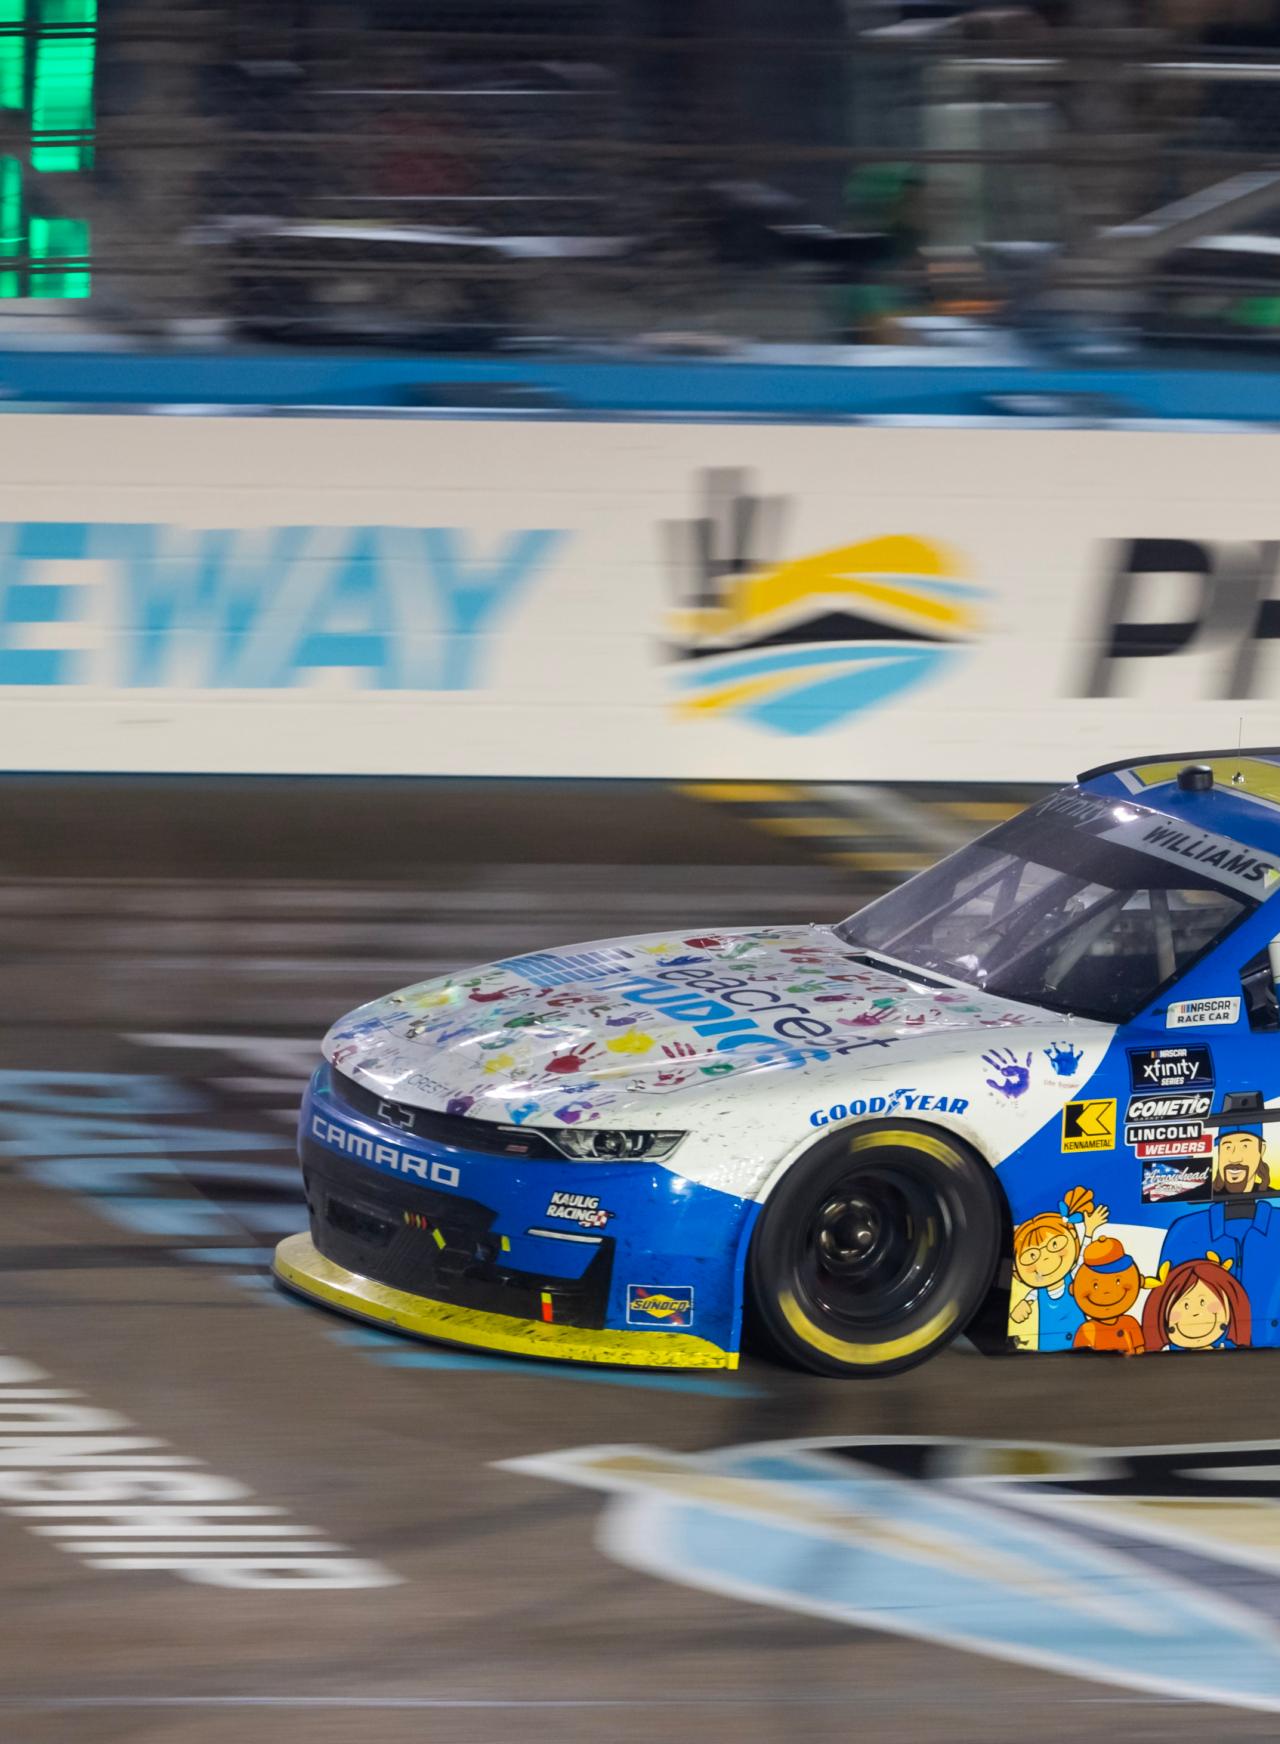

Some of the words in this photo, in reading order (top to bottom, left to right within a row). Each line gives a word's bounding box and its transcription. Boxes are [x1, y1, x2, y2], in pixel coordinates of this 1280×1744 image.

[1142, 824, 1274, 882] WILLIAMS
[1190, 1000, 1231, 1013] NASCAR
[1177, 1014, 1205, 1023] RACE
[1208, 1012, 1229, 1021] CAR
[1159, 1049, 1187, 1058] NASCAR
[1143, 1059, 1200, 1082] xfinity
[1161, 1077, 1184, 1086] SERIES
[1128, 1095, 1210, 1118] COMETIC
[1129, 1125, 1199, 1142] LINCOLN
[312, 1116, 460, 1188] CAMARO
[1064, 1139, 1112, 1150] KENNAMETAL
[1145, 1141, 1206, 1156] WELDERS
[551, 1191, 599, 1208] KAULIG
[546, 1205, 597, 1221] RACING
[633, 1300, 688, 1312] SUNOCO
